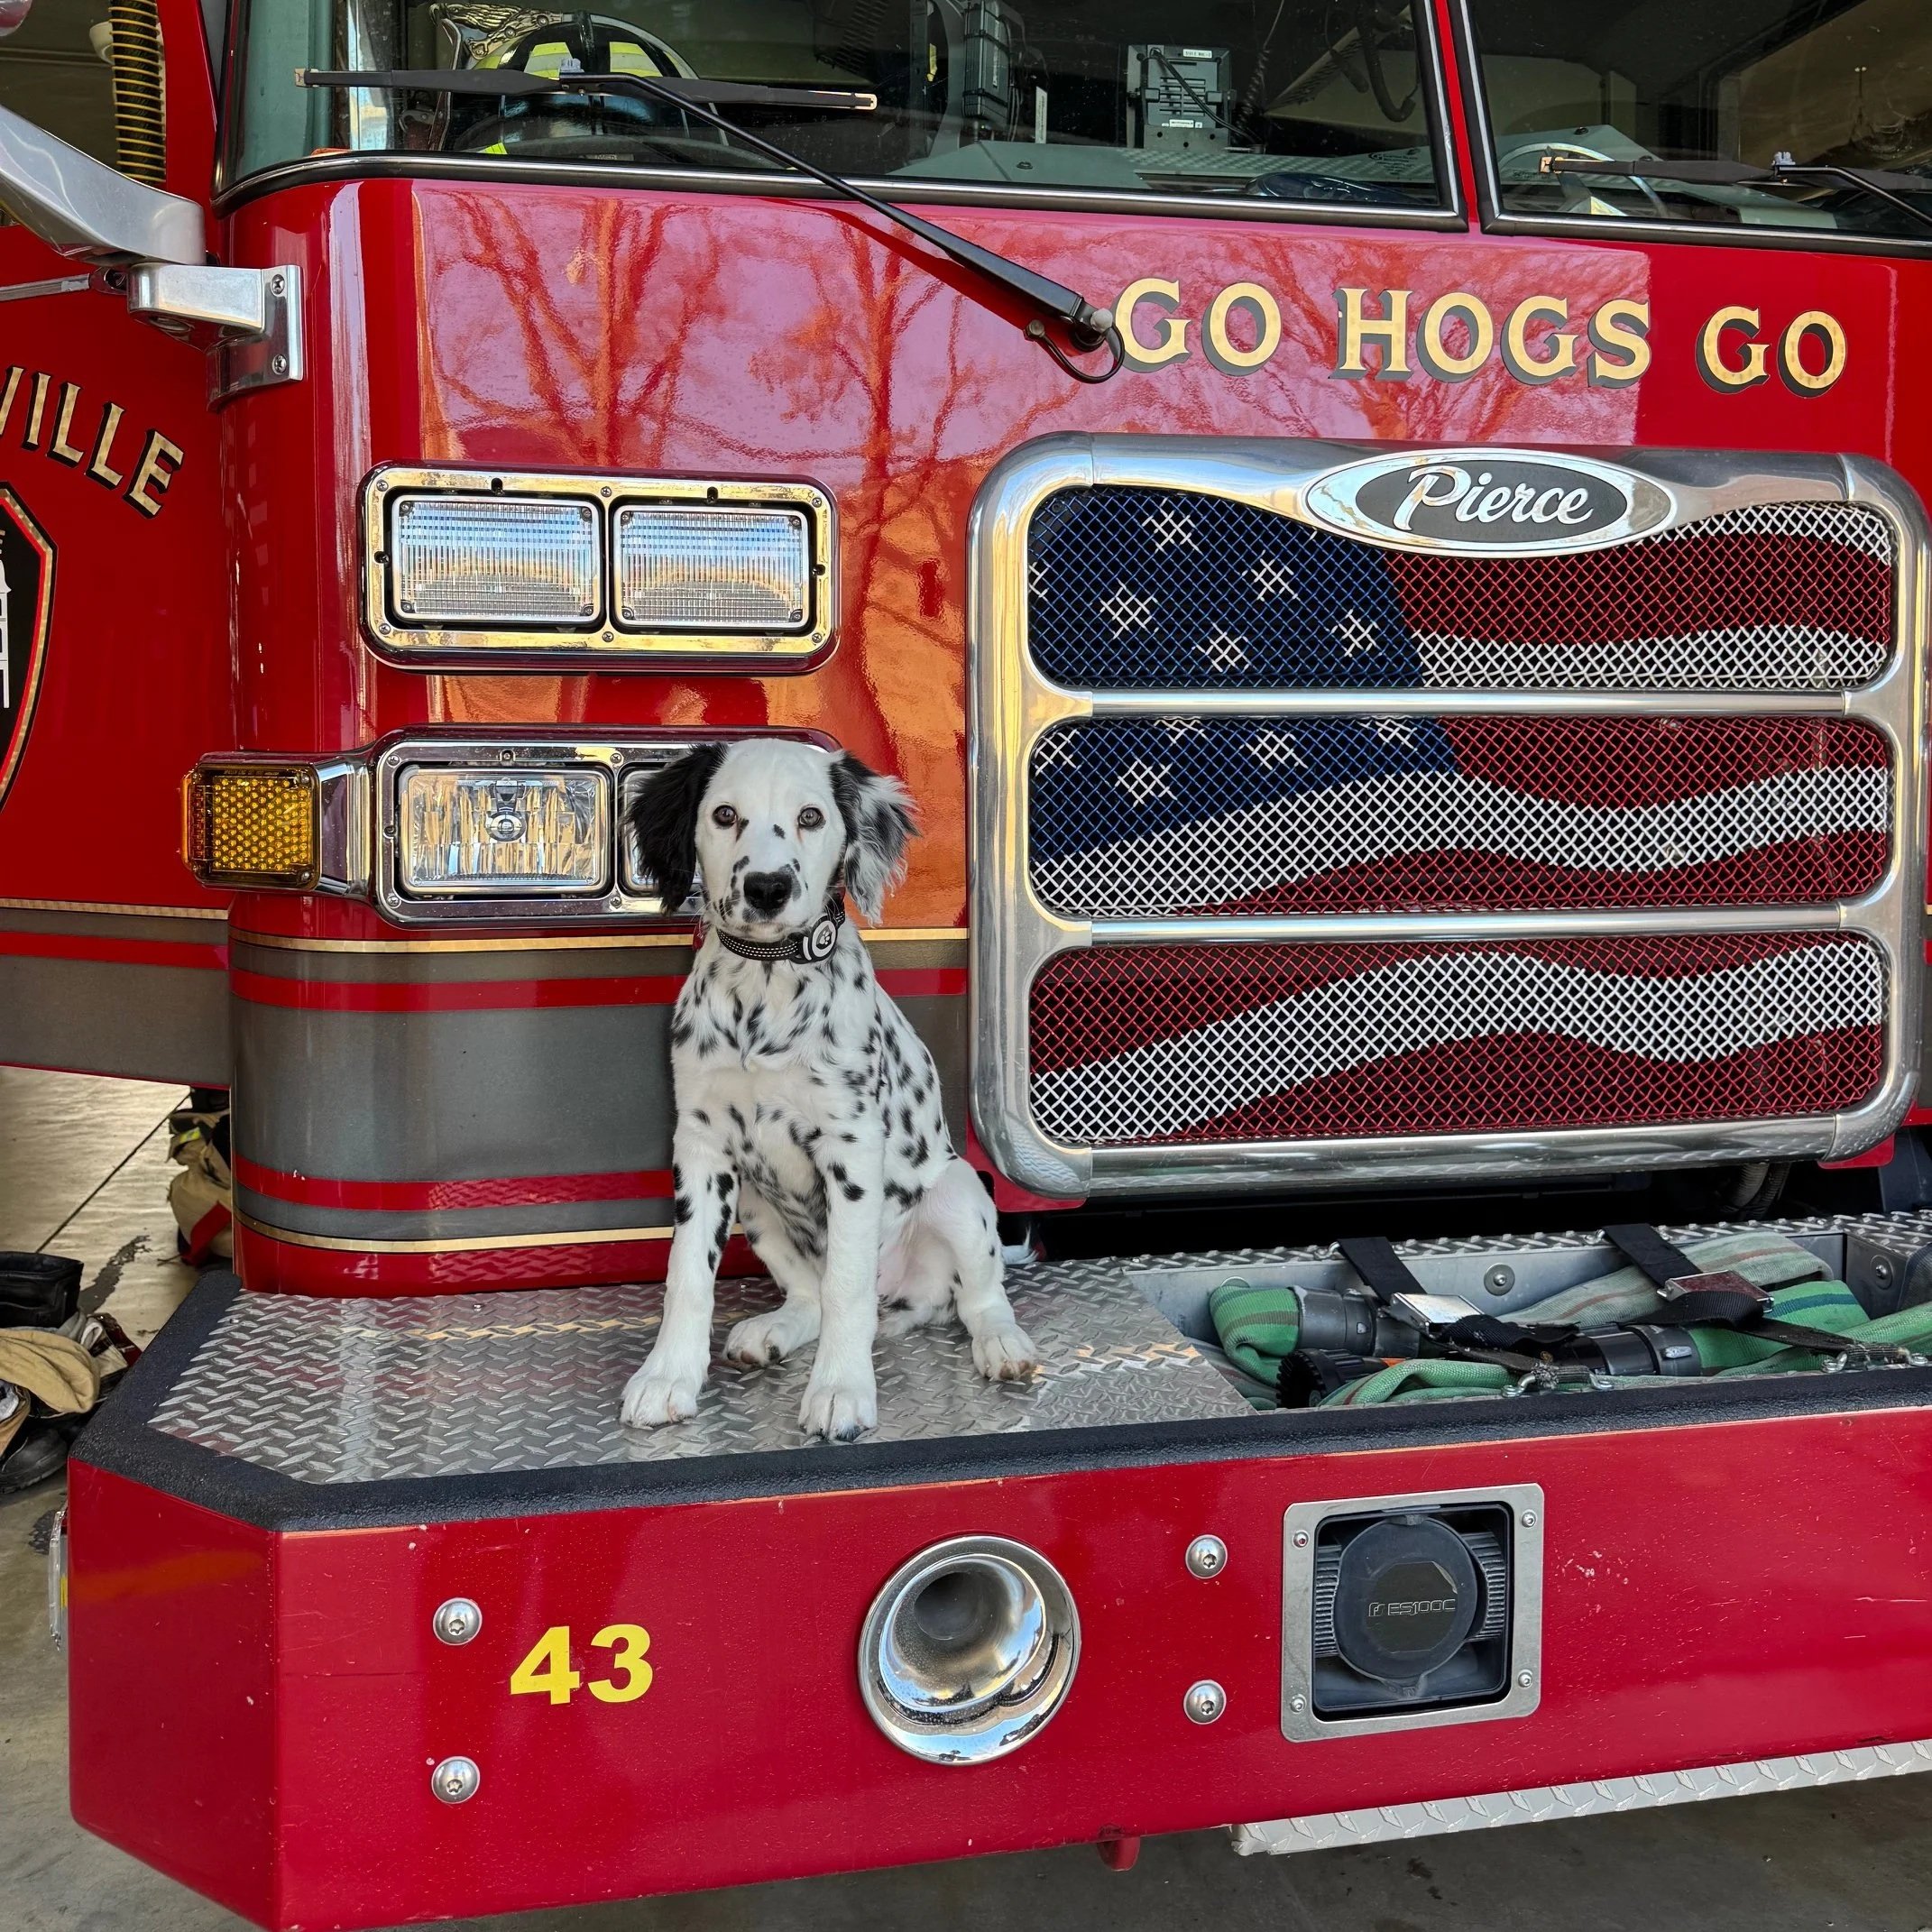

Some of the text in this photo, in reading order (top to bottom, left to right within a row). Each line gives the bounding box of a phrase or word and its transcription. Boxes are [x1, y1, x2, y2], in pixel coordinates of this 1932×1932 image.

[1113, 279, 1849, 399] GO HOGS GO
[1391, 464, 1594, 532] Pierce
[510, 1624, 654, 1705] 43
